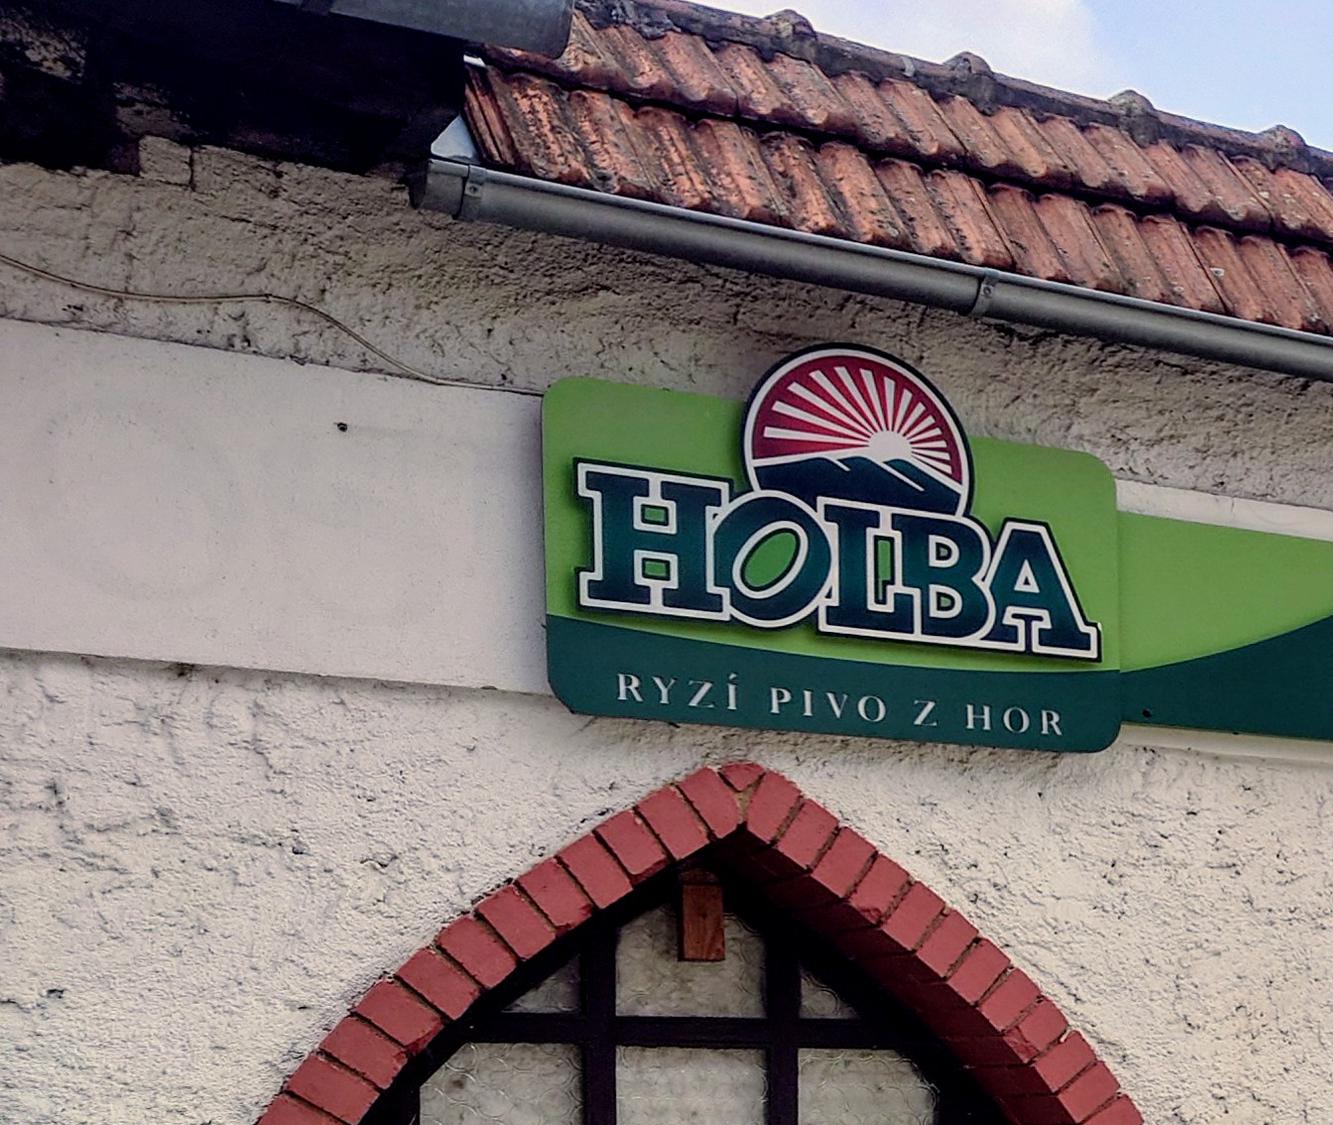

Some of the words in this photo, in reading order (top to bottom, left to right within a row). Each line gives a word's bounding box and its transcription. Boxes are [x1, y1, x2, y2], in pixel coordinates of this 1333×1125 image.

[573, 457, 1102, 662] HOLBA
[616, 673, 738, 710] RYZÍ
[770, 687, 887, 723] PIVO
[913, 699, 938, 726] Z
[964, 703, 1064, 736] HOR
